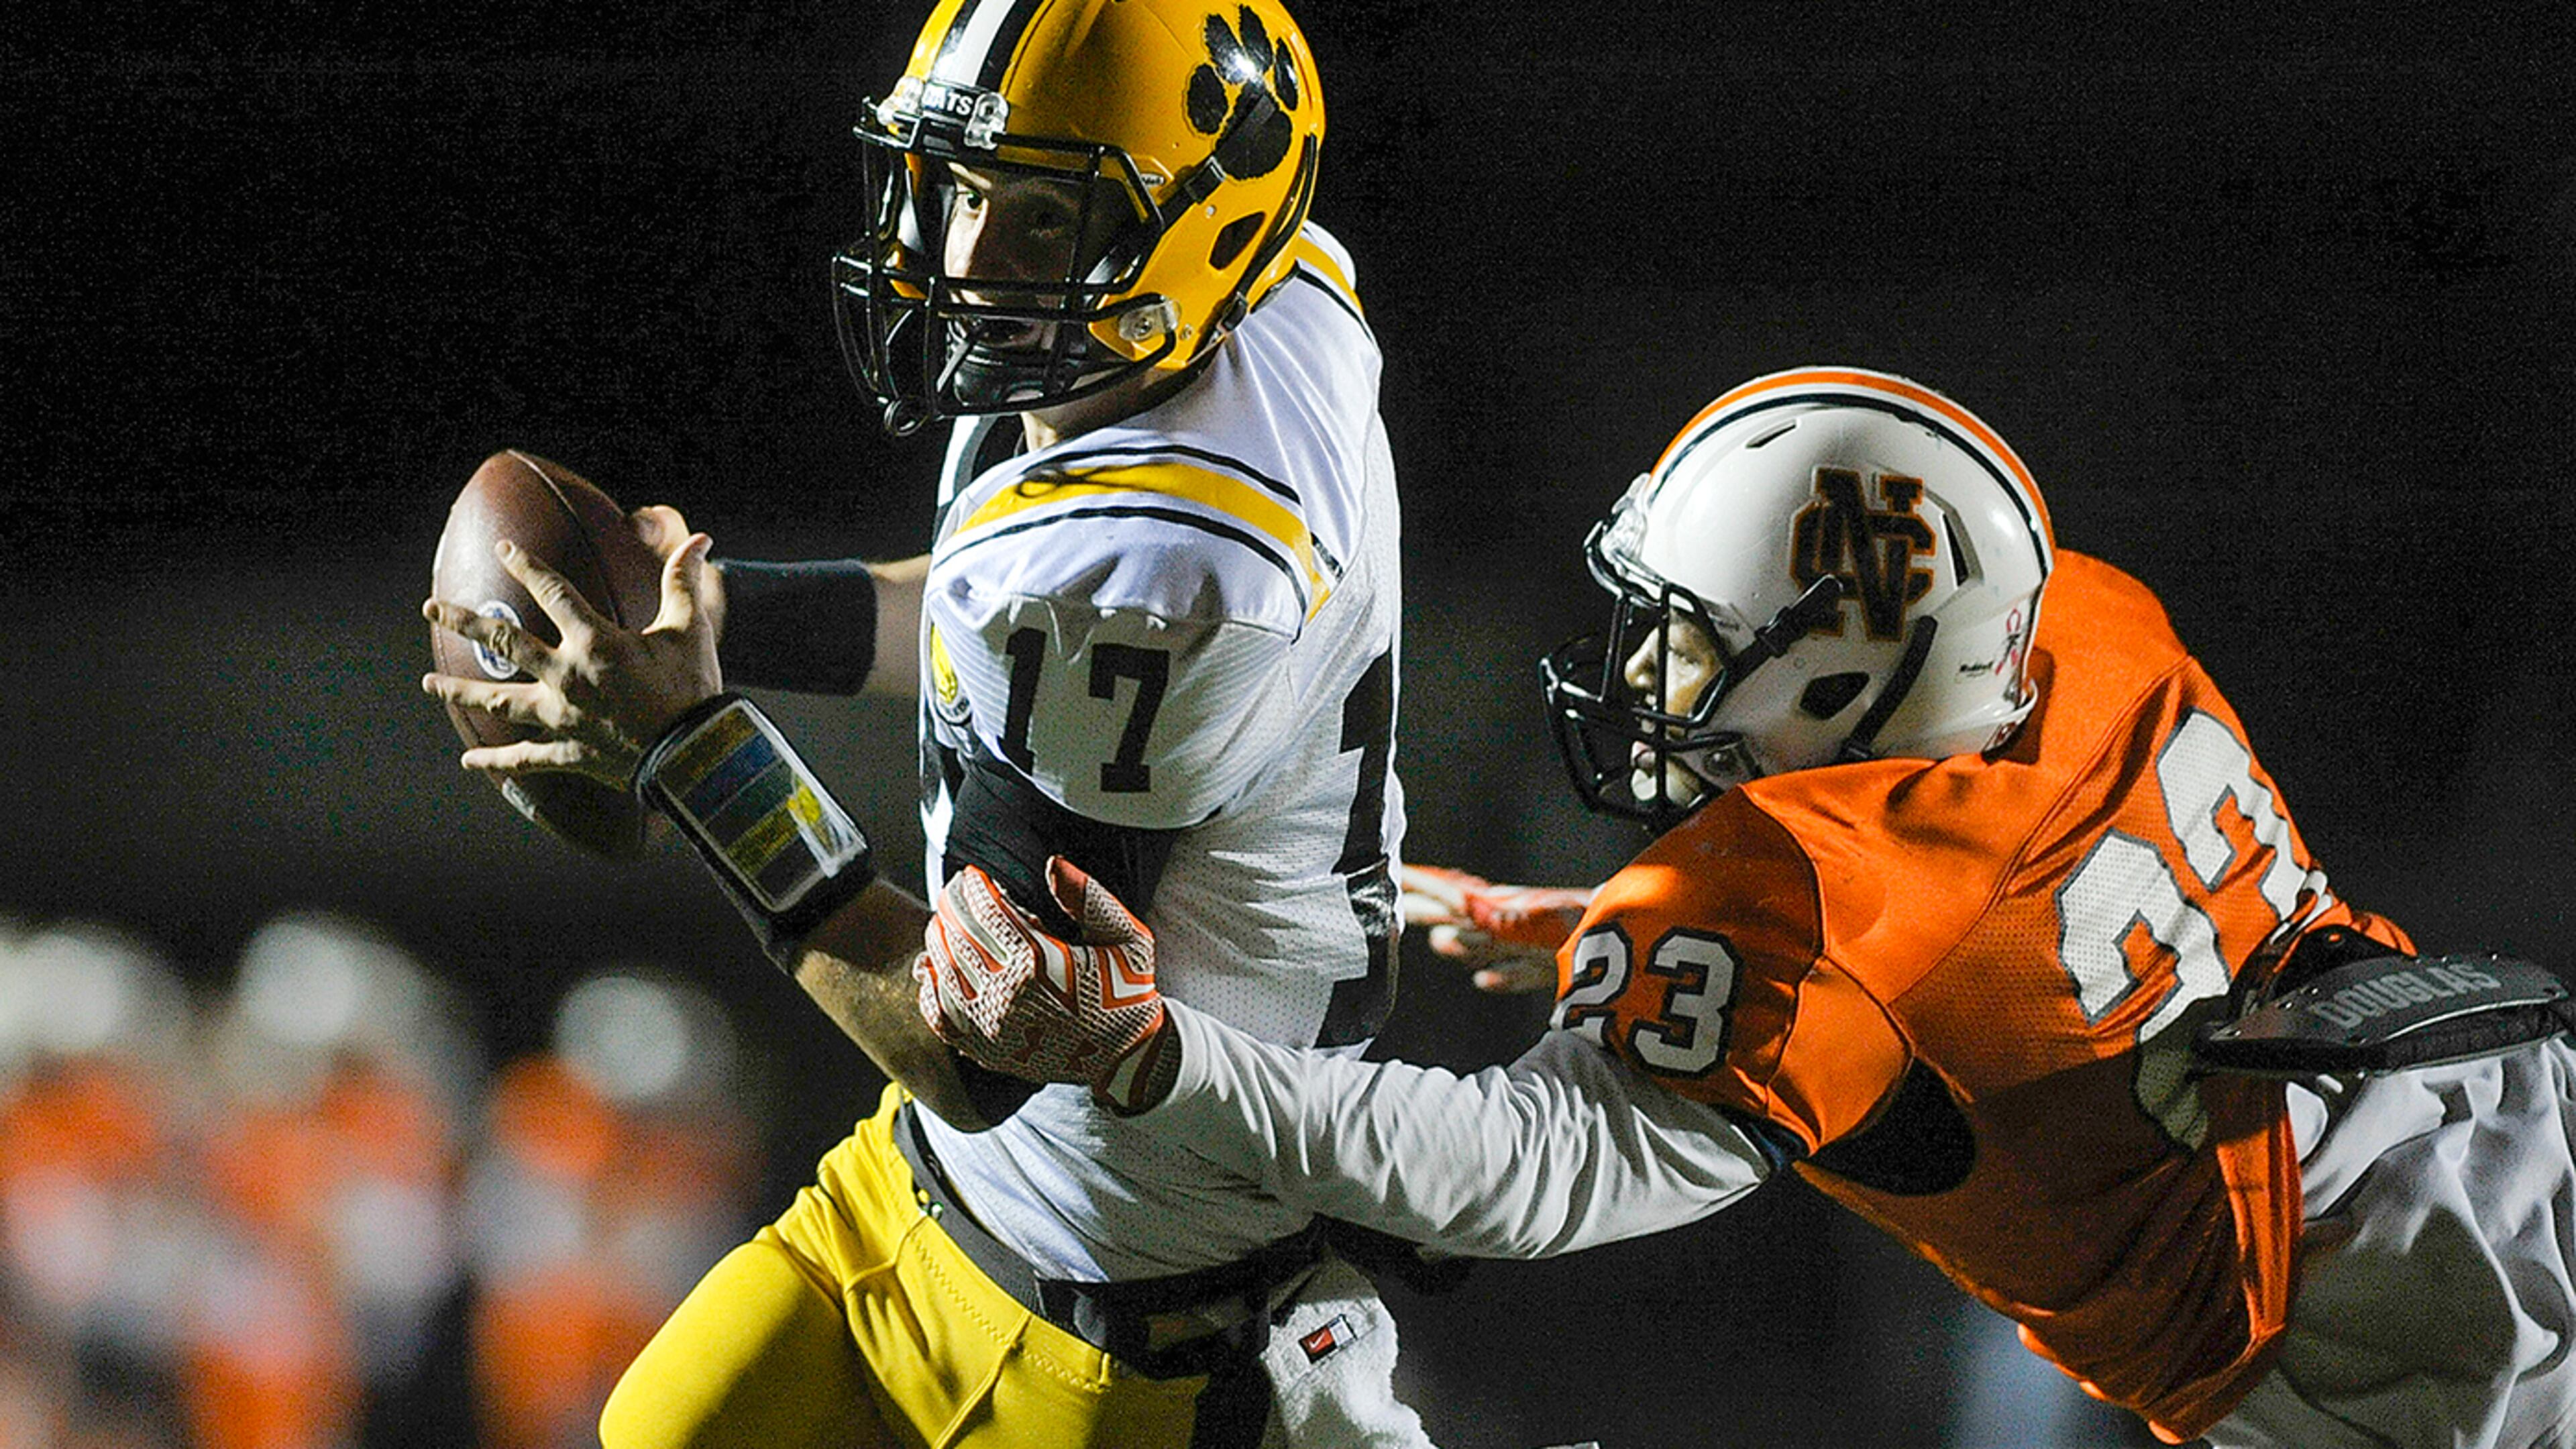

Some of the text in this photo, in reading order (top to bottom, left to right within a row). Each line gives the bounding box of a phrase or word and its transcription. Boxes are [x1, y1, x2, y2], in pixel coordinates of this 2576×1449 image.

[996, 626, 1170, 794] 17
[1550, 920, 1743, 1079] 23
[2311, 963, 2502, 1028] DOUGLAS
